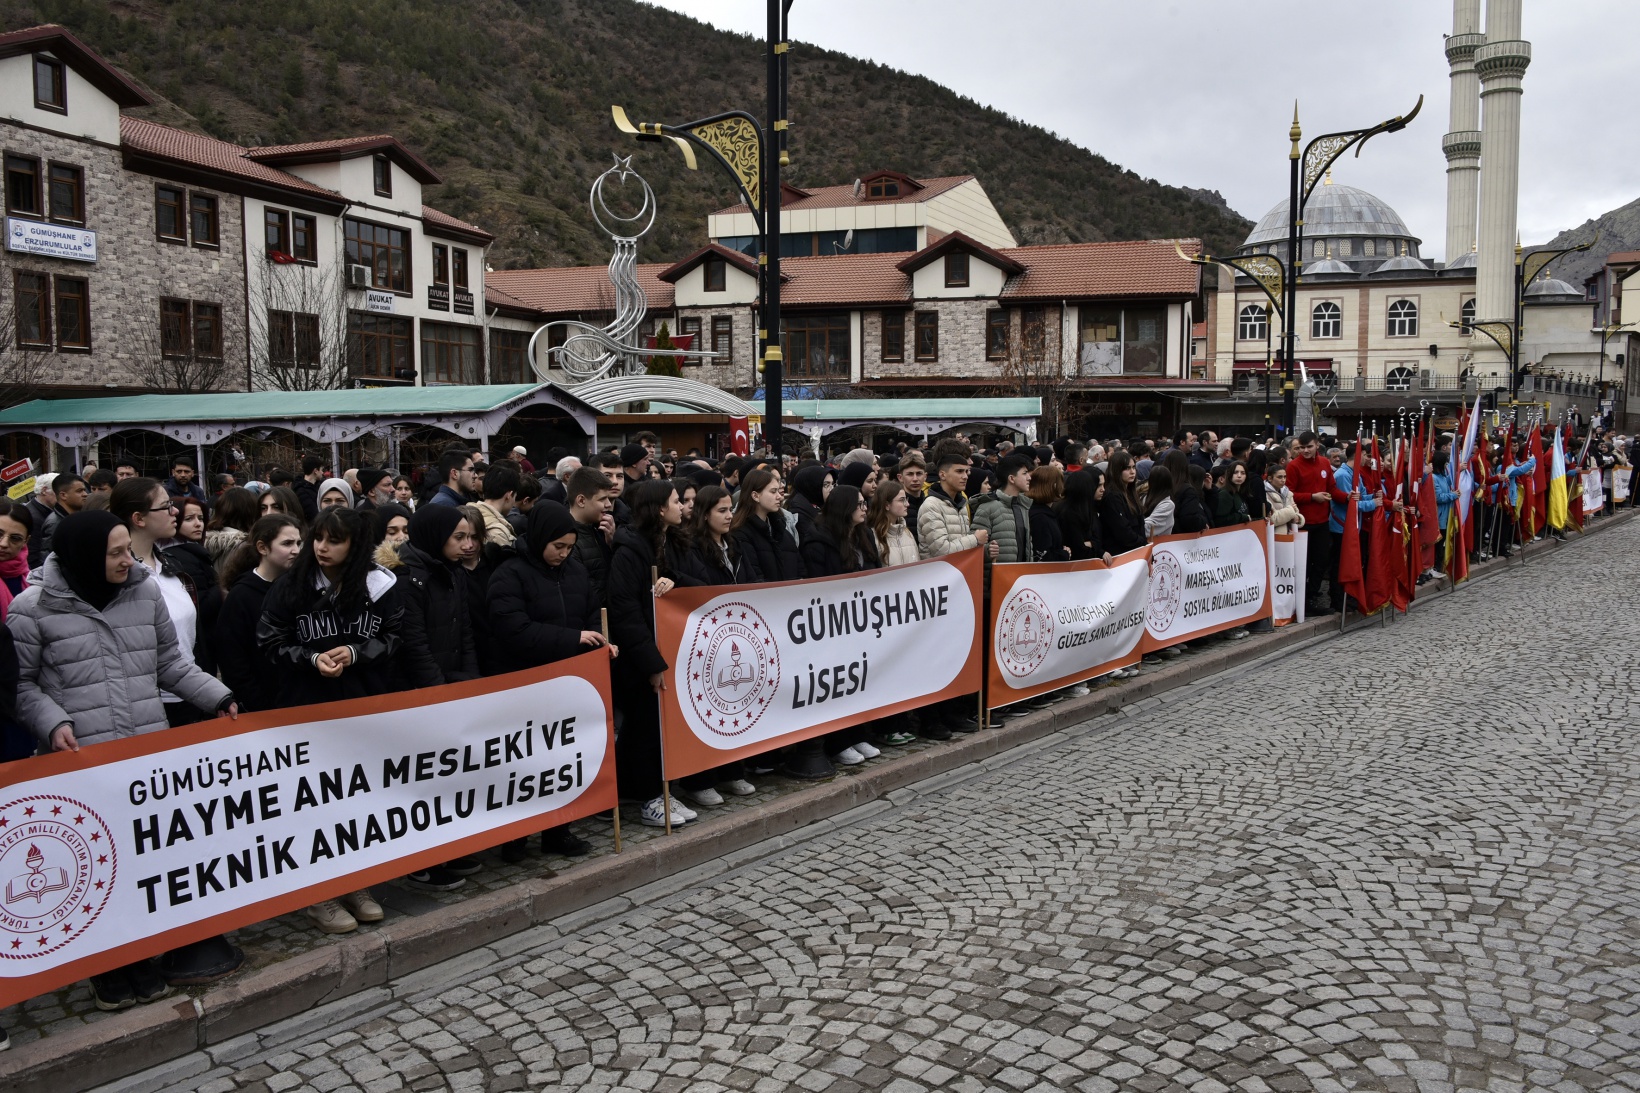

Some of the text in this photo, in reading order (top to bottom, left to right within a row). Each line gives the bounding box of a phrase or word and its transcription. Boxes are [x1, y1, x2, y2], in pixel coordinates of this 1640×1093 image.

[25, 238, 82, 251] ERZURUMLULAR
[31, 228, 76, 240] GÜMÜŞHANE
[369, 294, 392, 304] AVUKAT
[430, 289, 449, 299] AVUKAT
[455, 293, 473, 303] AVUKAT
[1183, 547, 1219, 564] GÜMÜŞHANE
[1185, 563, 1243, 590] MAREŞAL ÇAKMAK
[1057, 601, 1115, 624] GÜMÜŞHANE
[1183, 582, 1260, 618] SOSYAL BİLİMLER LİSESİ
[787, 585, 949, 645] GÜMÜŞHANE
[747, 632, 764, 661] EĞİTİM
[1057, 631, 1088, 650] GÜZEL
[705, 628, 728, 683] CUMHURİYETİ
[741, 663, 765, 706] BAKANLIĞI
[792, 652, 868, 709] LİSESİ
[707, 685, 729, 711] TÜRKİYE
[129, 741, 310, 806] GÜMÜŞHANE
[133, 716, 576, 856] HAYME ANA MESLEKİ VE
[61, 830, 87, 862] EĞİTİM
[137, 752, 583, 914] TEKNİK ANADOLU LİSESİ
[53, 865, 88, 920] BAKANLIĞI
